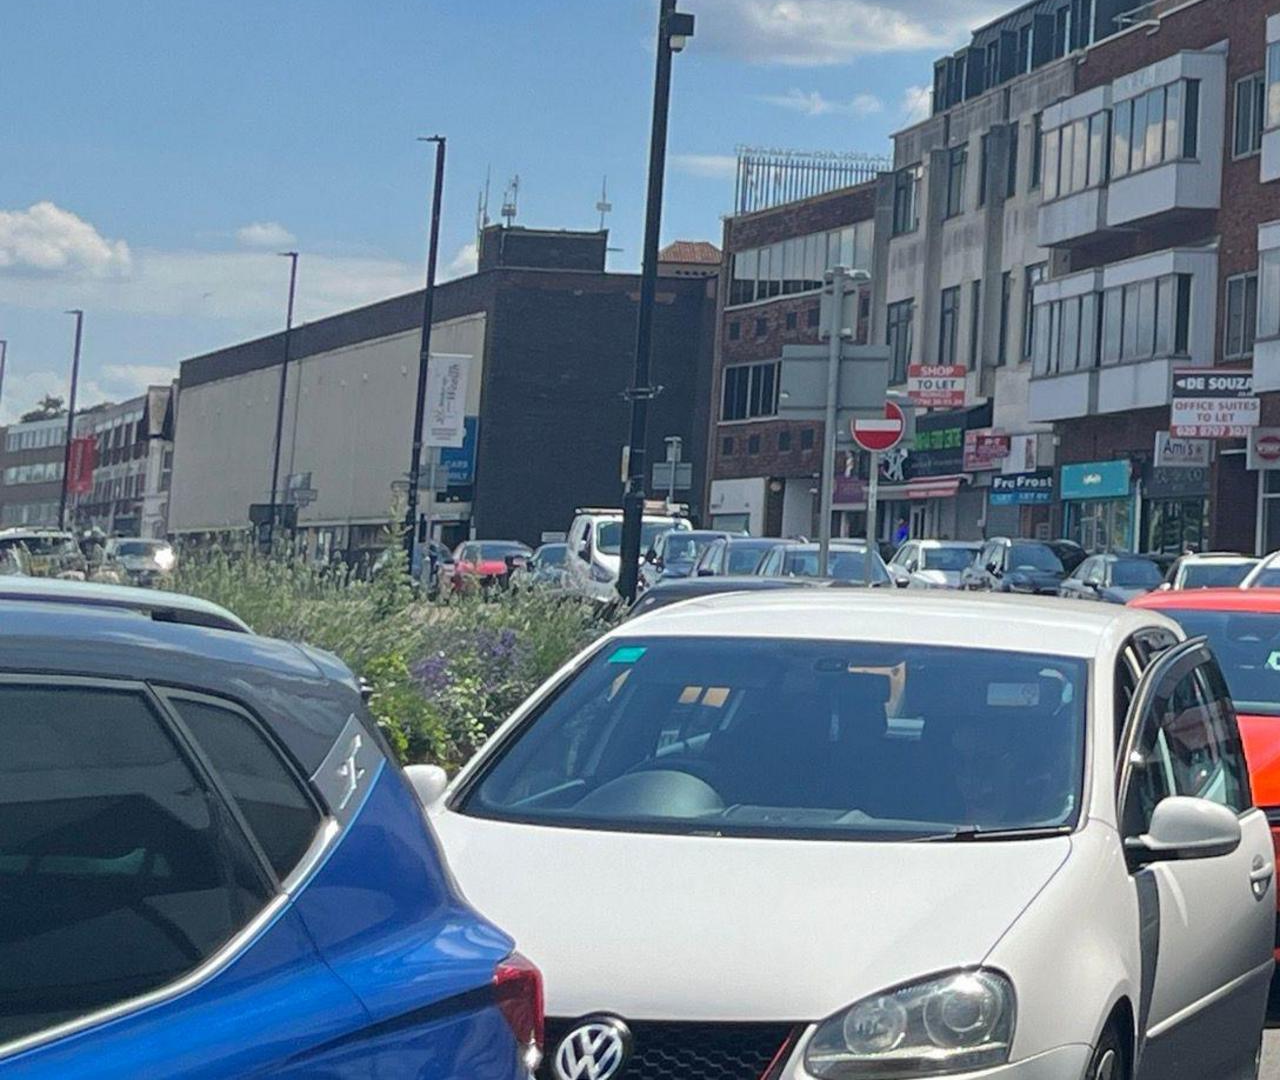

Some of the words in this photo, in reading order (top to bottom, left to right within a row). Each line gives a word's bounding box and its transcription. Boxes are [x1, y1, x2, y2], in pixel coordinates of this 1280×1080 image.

[920, 366, 954, 377] SHOP
[917, 379, 933, 390] TO
[936, 379, 957, 390] LET
[1186, 377, 1205, 390] DE
[1175, 401, 1214, 411] OFFICE
[1218, 401, 1257, 411] SUITES
[1197, 413, 1212, 421] TO
[1215, 413, 1234, 422] LET
[1016, 475, 1053, 488] Frost
